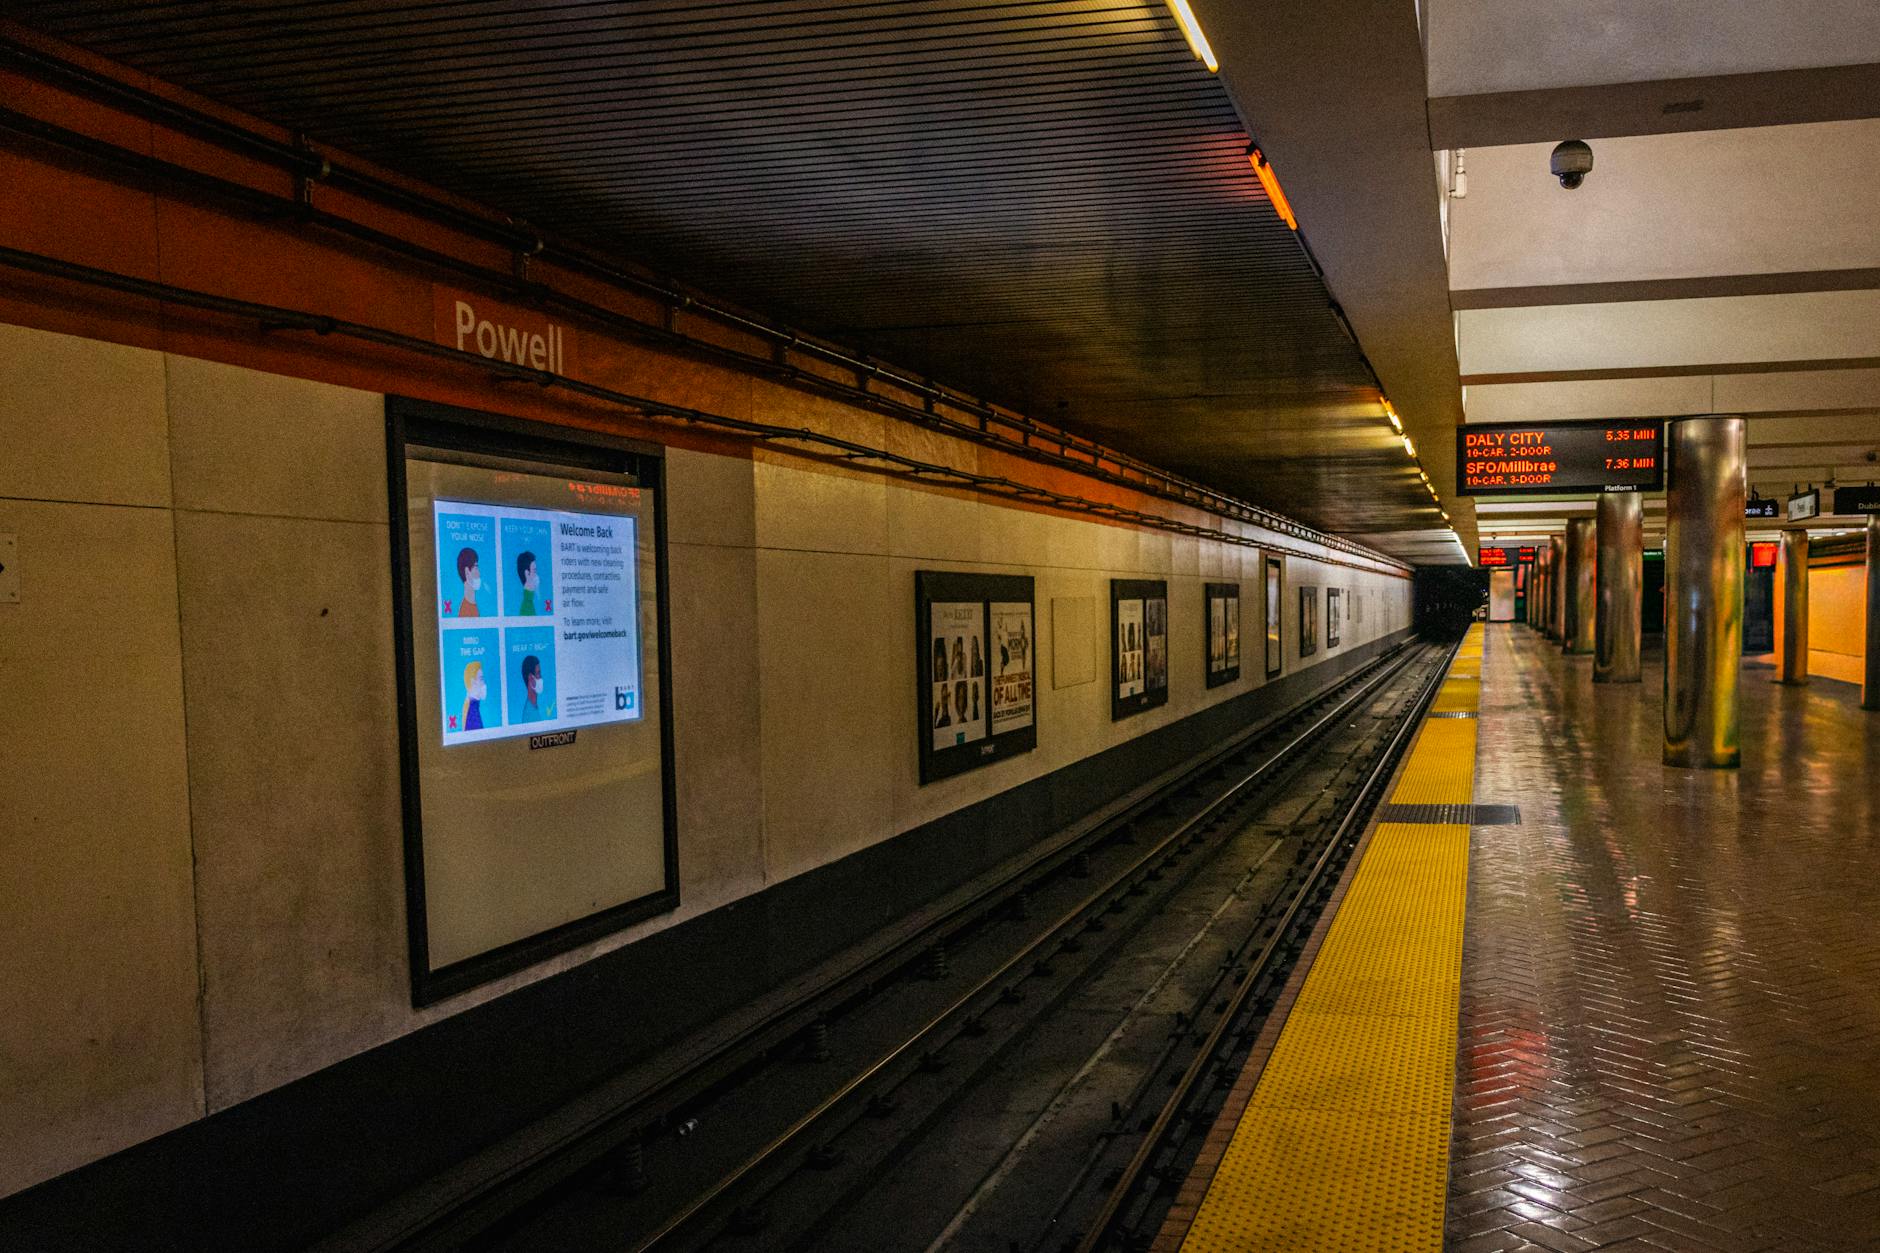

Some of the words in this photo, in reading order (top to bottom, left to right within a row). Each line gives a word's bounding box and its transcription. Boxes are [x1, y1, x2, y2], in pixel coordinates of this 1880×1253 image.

[455, 300, 563, 375] Powell
[1465, 433, 1505, 446] DALY
[1509, 431, 1544, 445] CITY
[1633, 429, 1655, 440] MIN
[1510, 446, 1551, 456] 2-DOOR
[1466, 461, 1556, 474] SFO/Millbrae
[1633, 457, 1654, 468] MIN
[1510, 474, 1551, 484] 3-DOOR
[1604, 484, 1633, 492] Platform
[560, 522, 595, 538] Welcome
[596, 526, 613, 538] Back
[561, 542, 576, 552] BART
[581, 544, 610, 556] welcoming
[610, 546, 622, 554] back
[561, 558, 577, 566] riders
[577, 558, 590, 567] with
[591, 559, 602, 567] new
[603, 559, 624, 570] cleaning
[562, 585, 586, 597] payment
[587, 585, 597, 594] and
[597, 585, 609, 594] safe
[563, 617, 571, 626] To
[571, 616, 585, 626] learn
[563, 629, 626, 642] bart.gov/welcomeback
[531, 732, 575, 748] OUTFRONT
